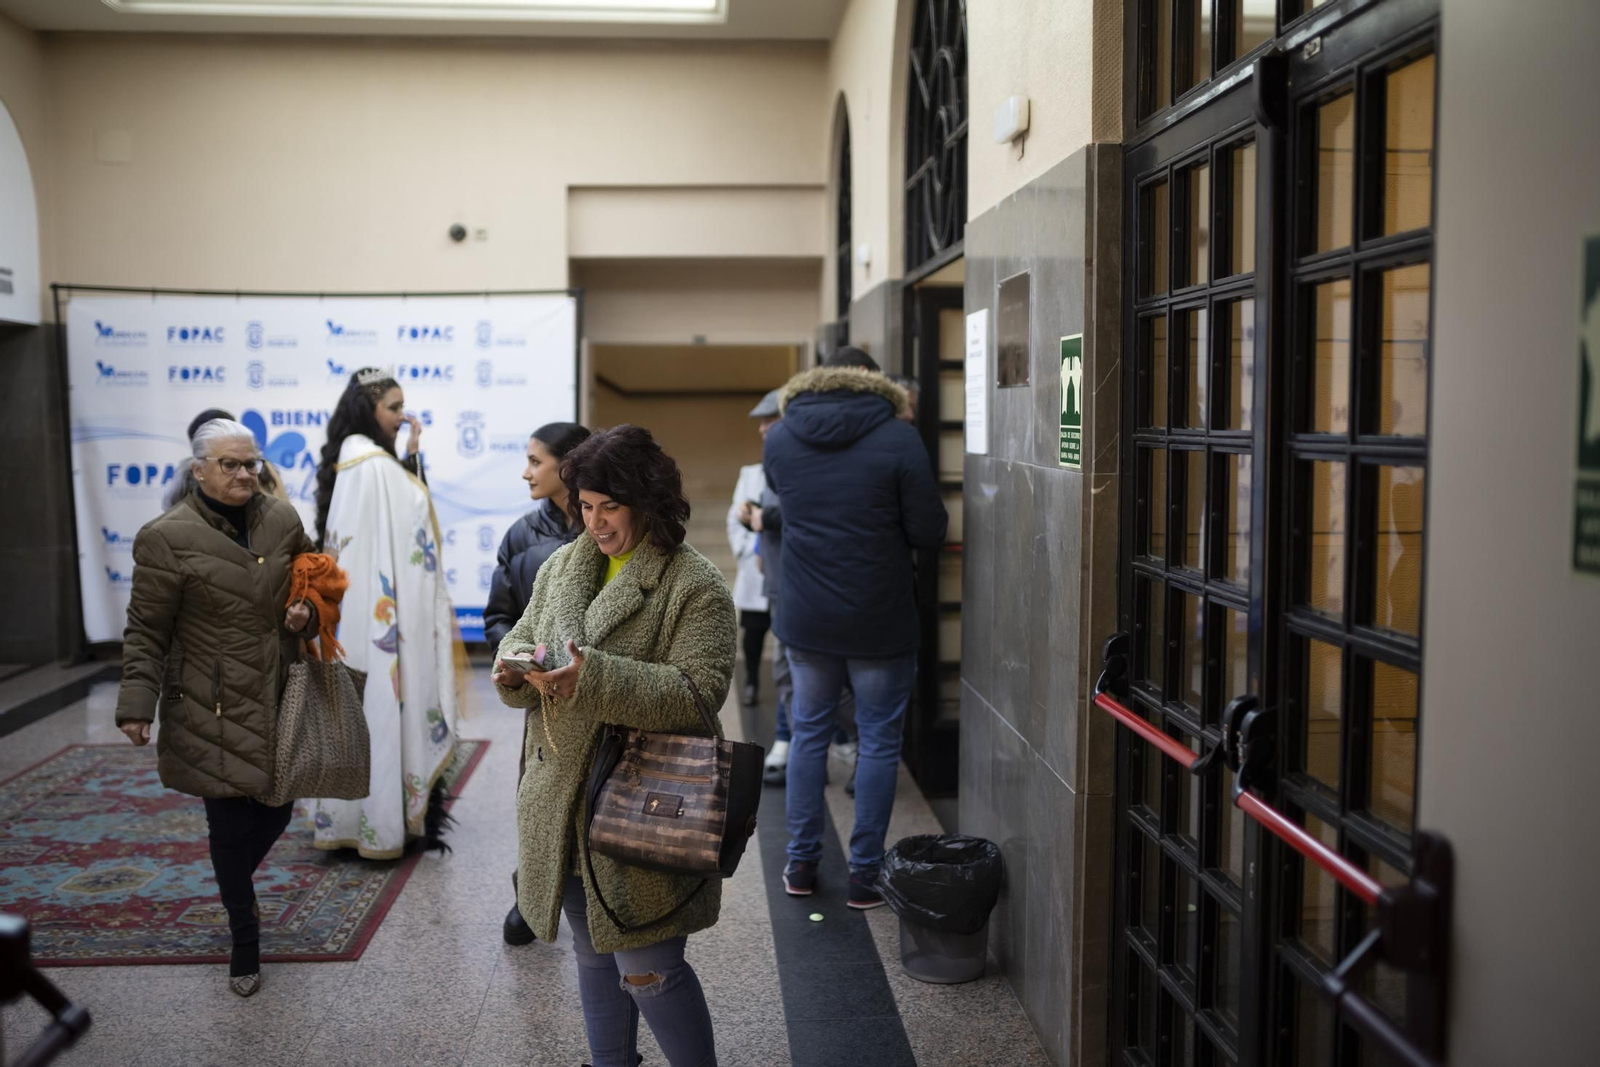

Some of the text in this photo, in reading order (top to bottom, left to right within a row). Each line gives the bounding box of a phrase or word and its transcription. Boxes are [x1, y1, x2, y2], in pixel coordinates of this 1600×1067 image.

[167, 326, 225, 342] FOPAC
[397, 325, 455, 342] FOPAC
[168, 365, 226, 382] FOPAC
[397, 365, 455, 381] FOPAC
[107, 464, 174, 486] FOPA
